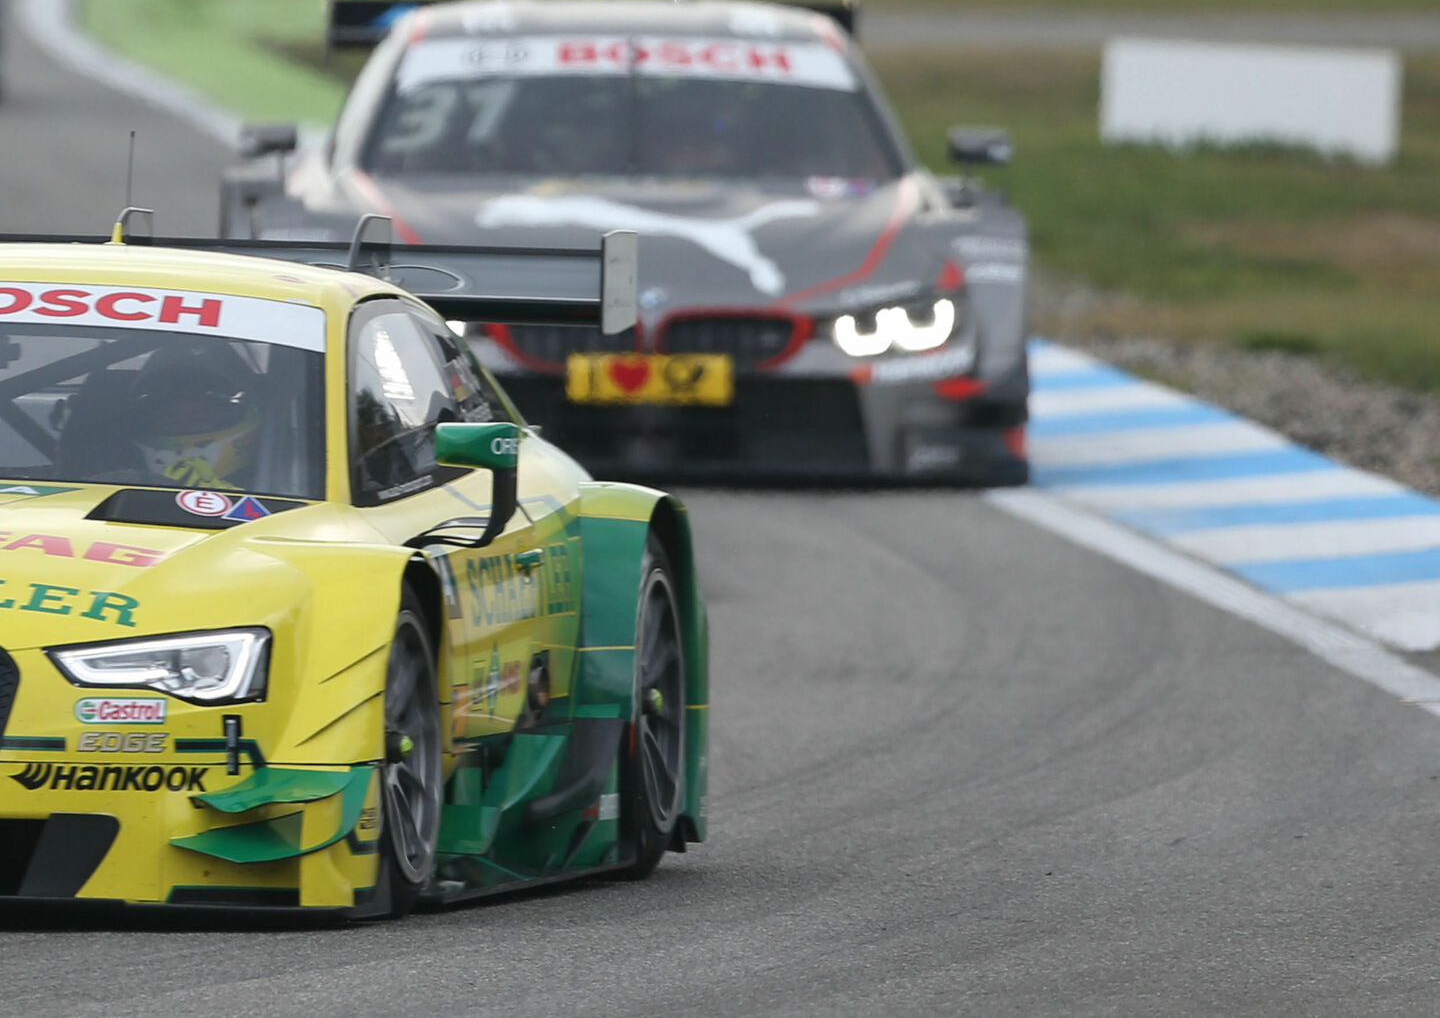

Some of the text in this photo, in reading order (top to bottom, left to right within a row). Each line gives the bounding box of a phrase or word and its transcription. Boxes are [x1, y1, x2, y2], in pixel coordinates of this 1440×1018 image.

[555, 42, 792, 73] BOSCH
[378, 83, 516, 151] 31
[99, 701, 165, 721] Castrol
[77, 733, 170, 753] EDGE
